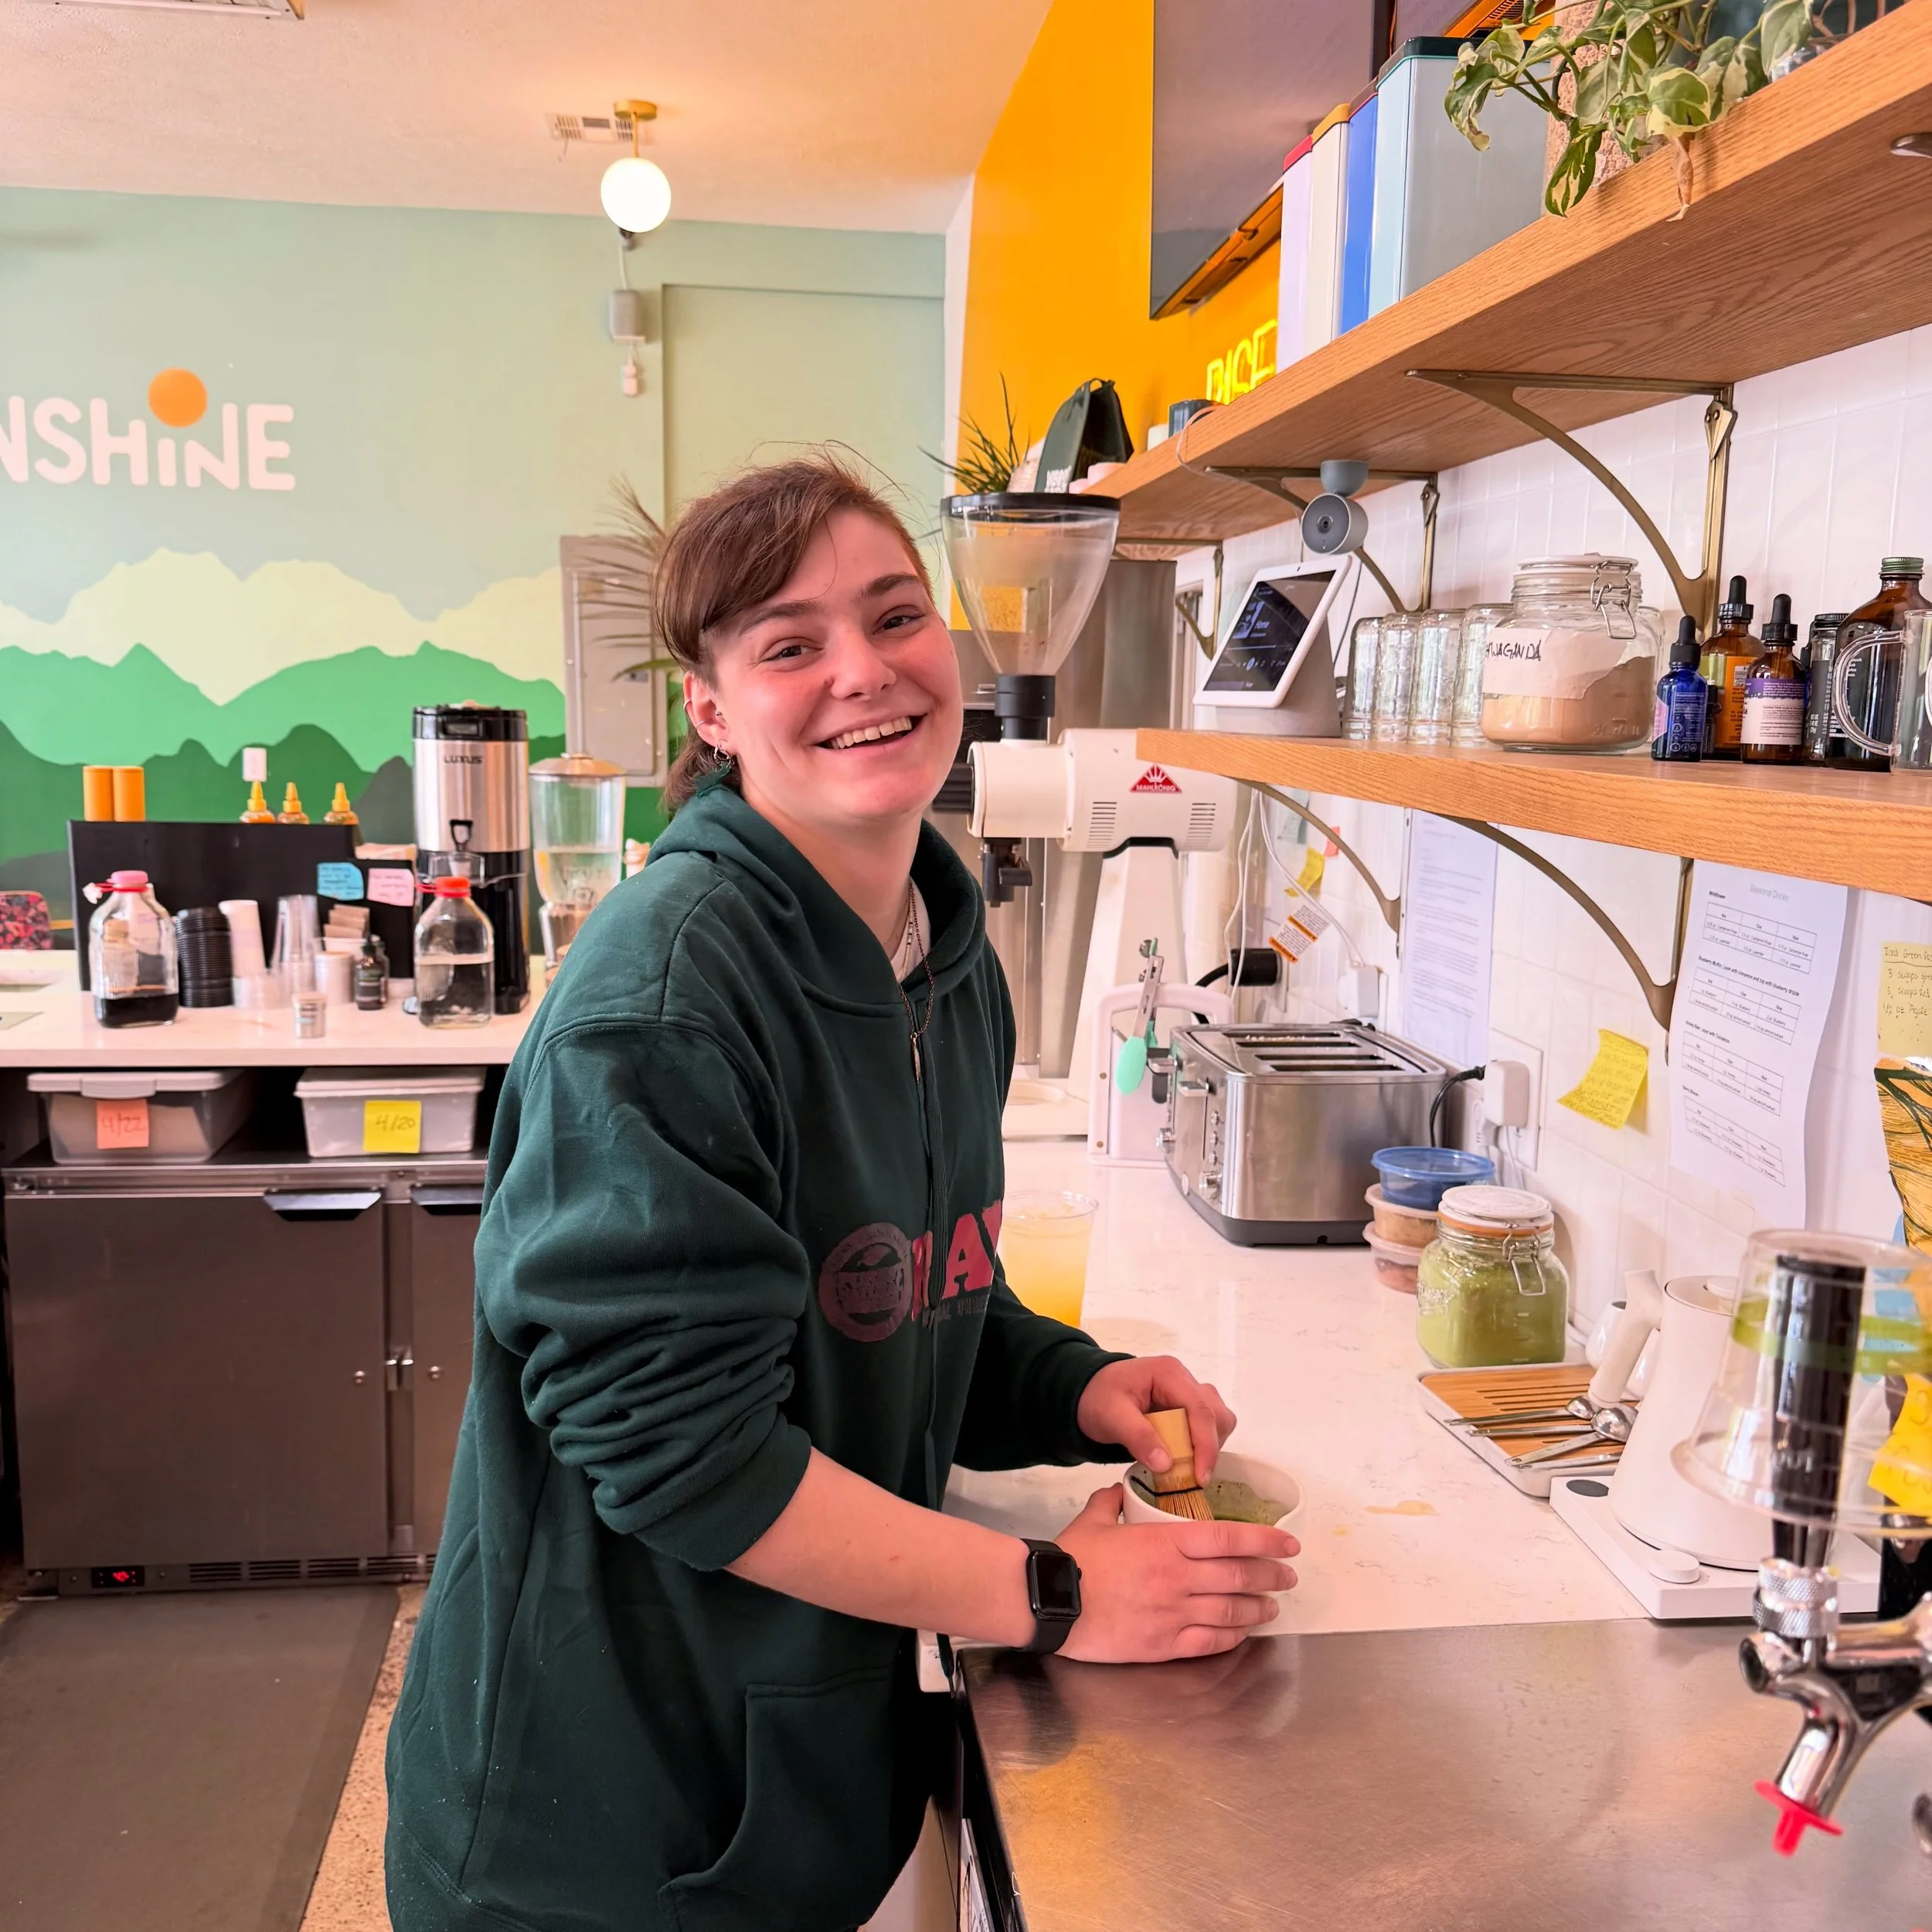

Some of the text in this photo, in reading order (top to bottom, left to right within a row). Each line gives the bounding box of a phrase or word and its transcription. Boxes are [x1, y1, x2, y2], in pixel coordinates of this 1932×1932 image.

[1903, 948, 1921, 959] Green
[1887, 968, 1893, 978] 3
[101, 1112, 148, 1138] 4/22
[376, 1114, 417, 1132] 4/20
